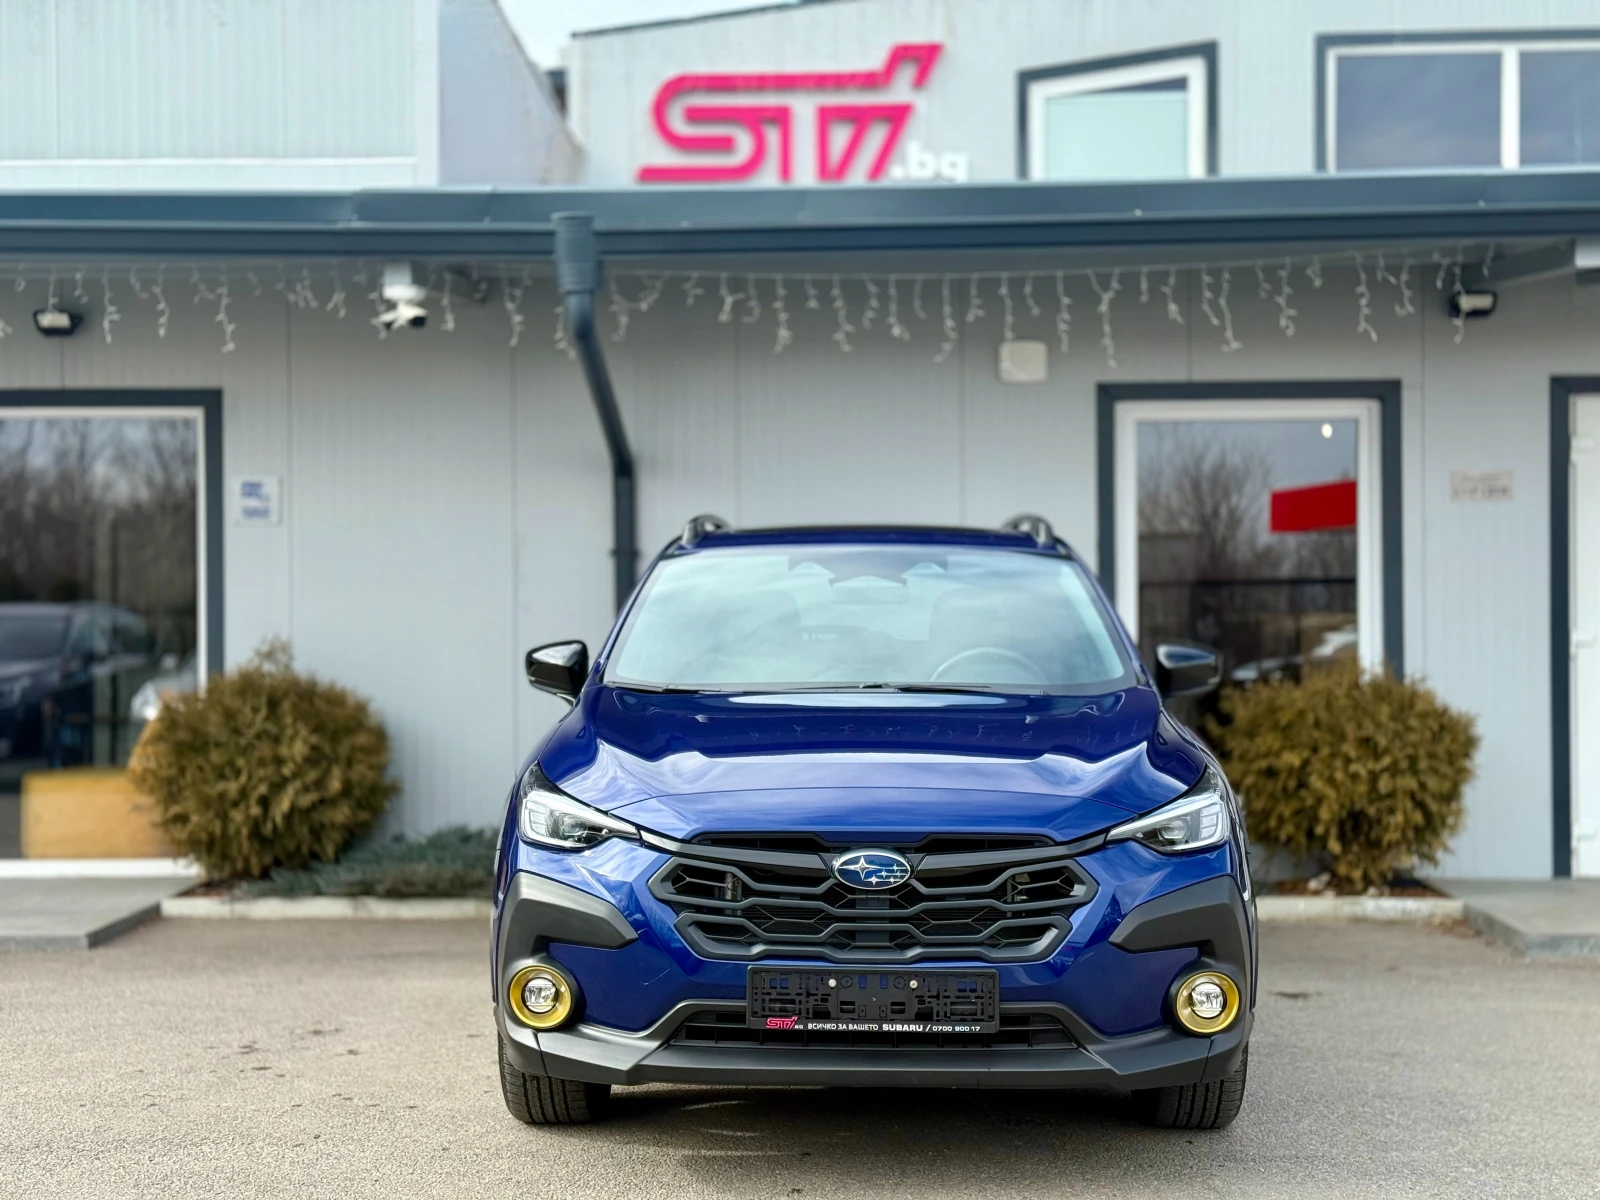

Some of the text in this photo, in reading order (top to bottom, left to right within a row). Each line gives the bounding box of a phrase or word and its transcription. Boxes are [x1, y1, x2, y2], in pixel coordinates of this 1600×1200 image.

[807, 1022, 837, 1030] ВСИЧКО
[837, 1023, 848, 1031] ЗА
[848, 1023, 879, 1031] ВАШЕТО
[882, 1023, 923, 1032] SUBARU
